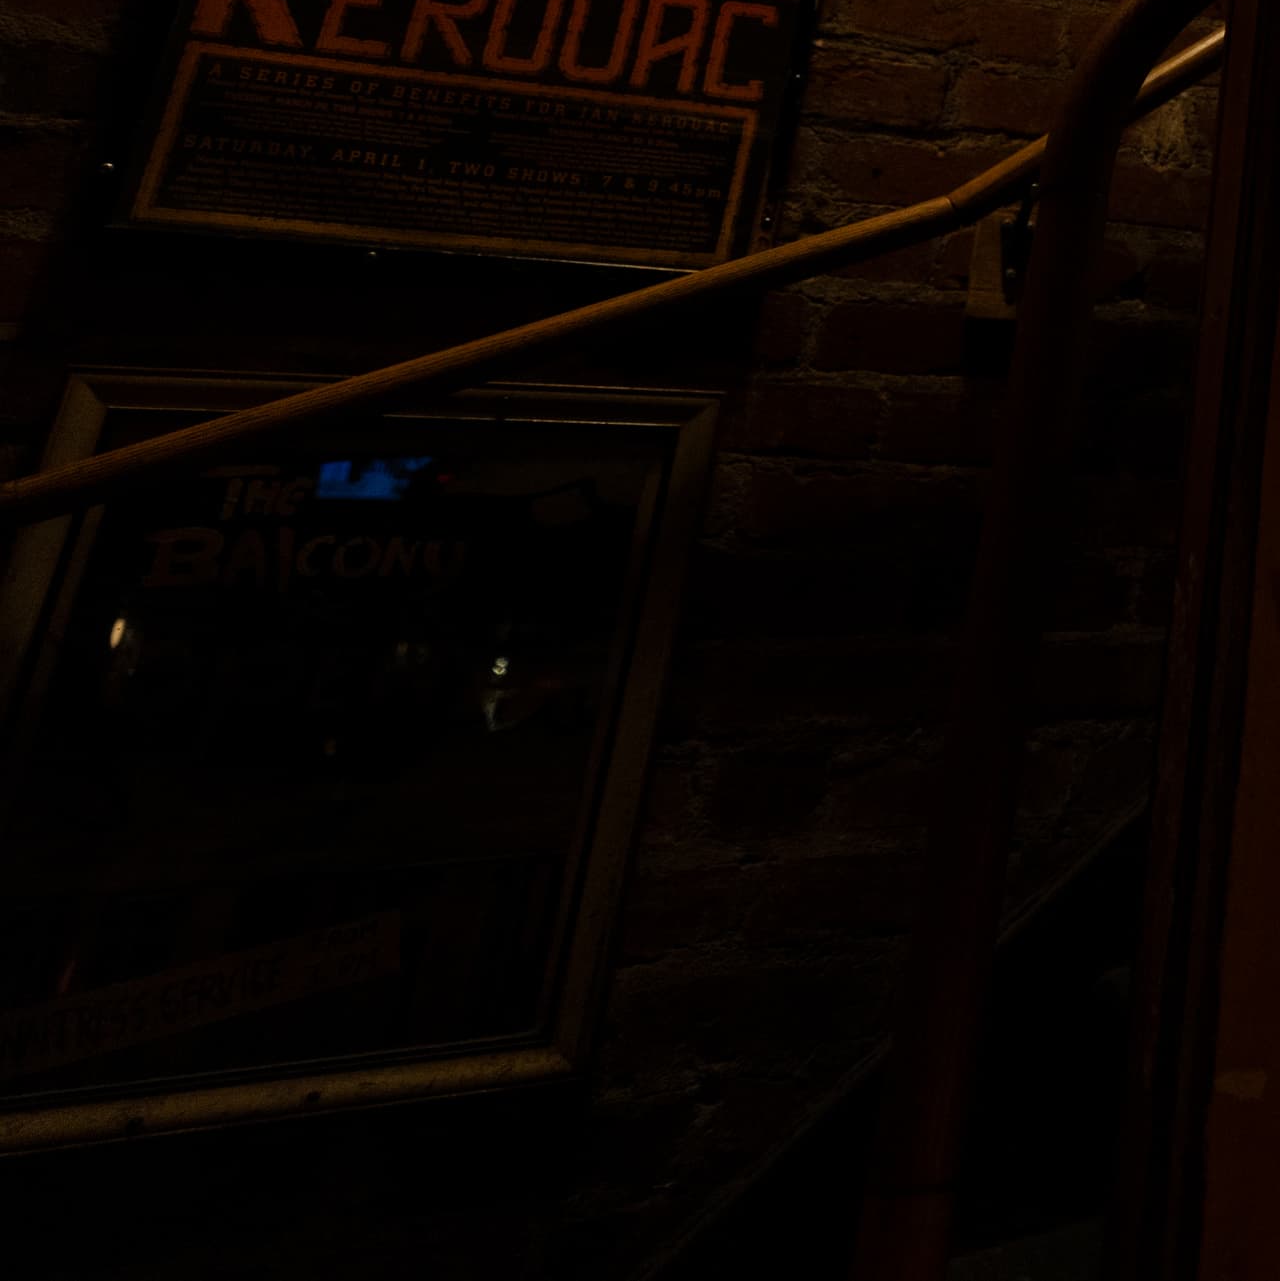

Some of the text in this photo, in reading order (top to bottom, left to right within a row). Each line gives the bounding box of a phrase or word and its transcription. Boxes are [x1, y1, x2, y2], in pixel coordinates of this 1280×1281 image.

[238, 66, 337, 91] SERIES
[349, 79, 381, 95] OF
[391, 84, 512, 110] BENEFITS
[524, 98, 569, 118] FOR
[330, 147, 402, 169] APRIL
[447, 160, 497, 179] TWO
